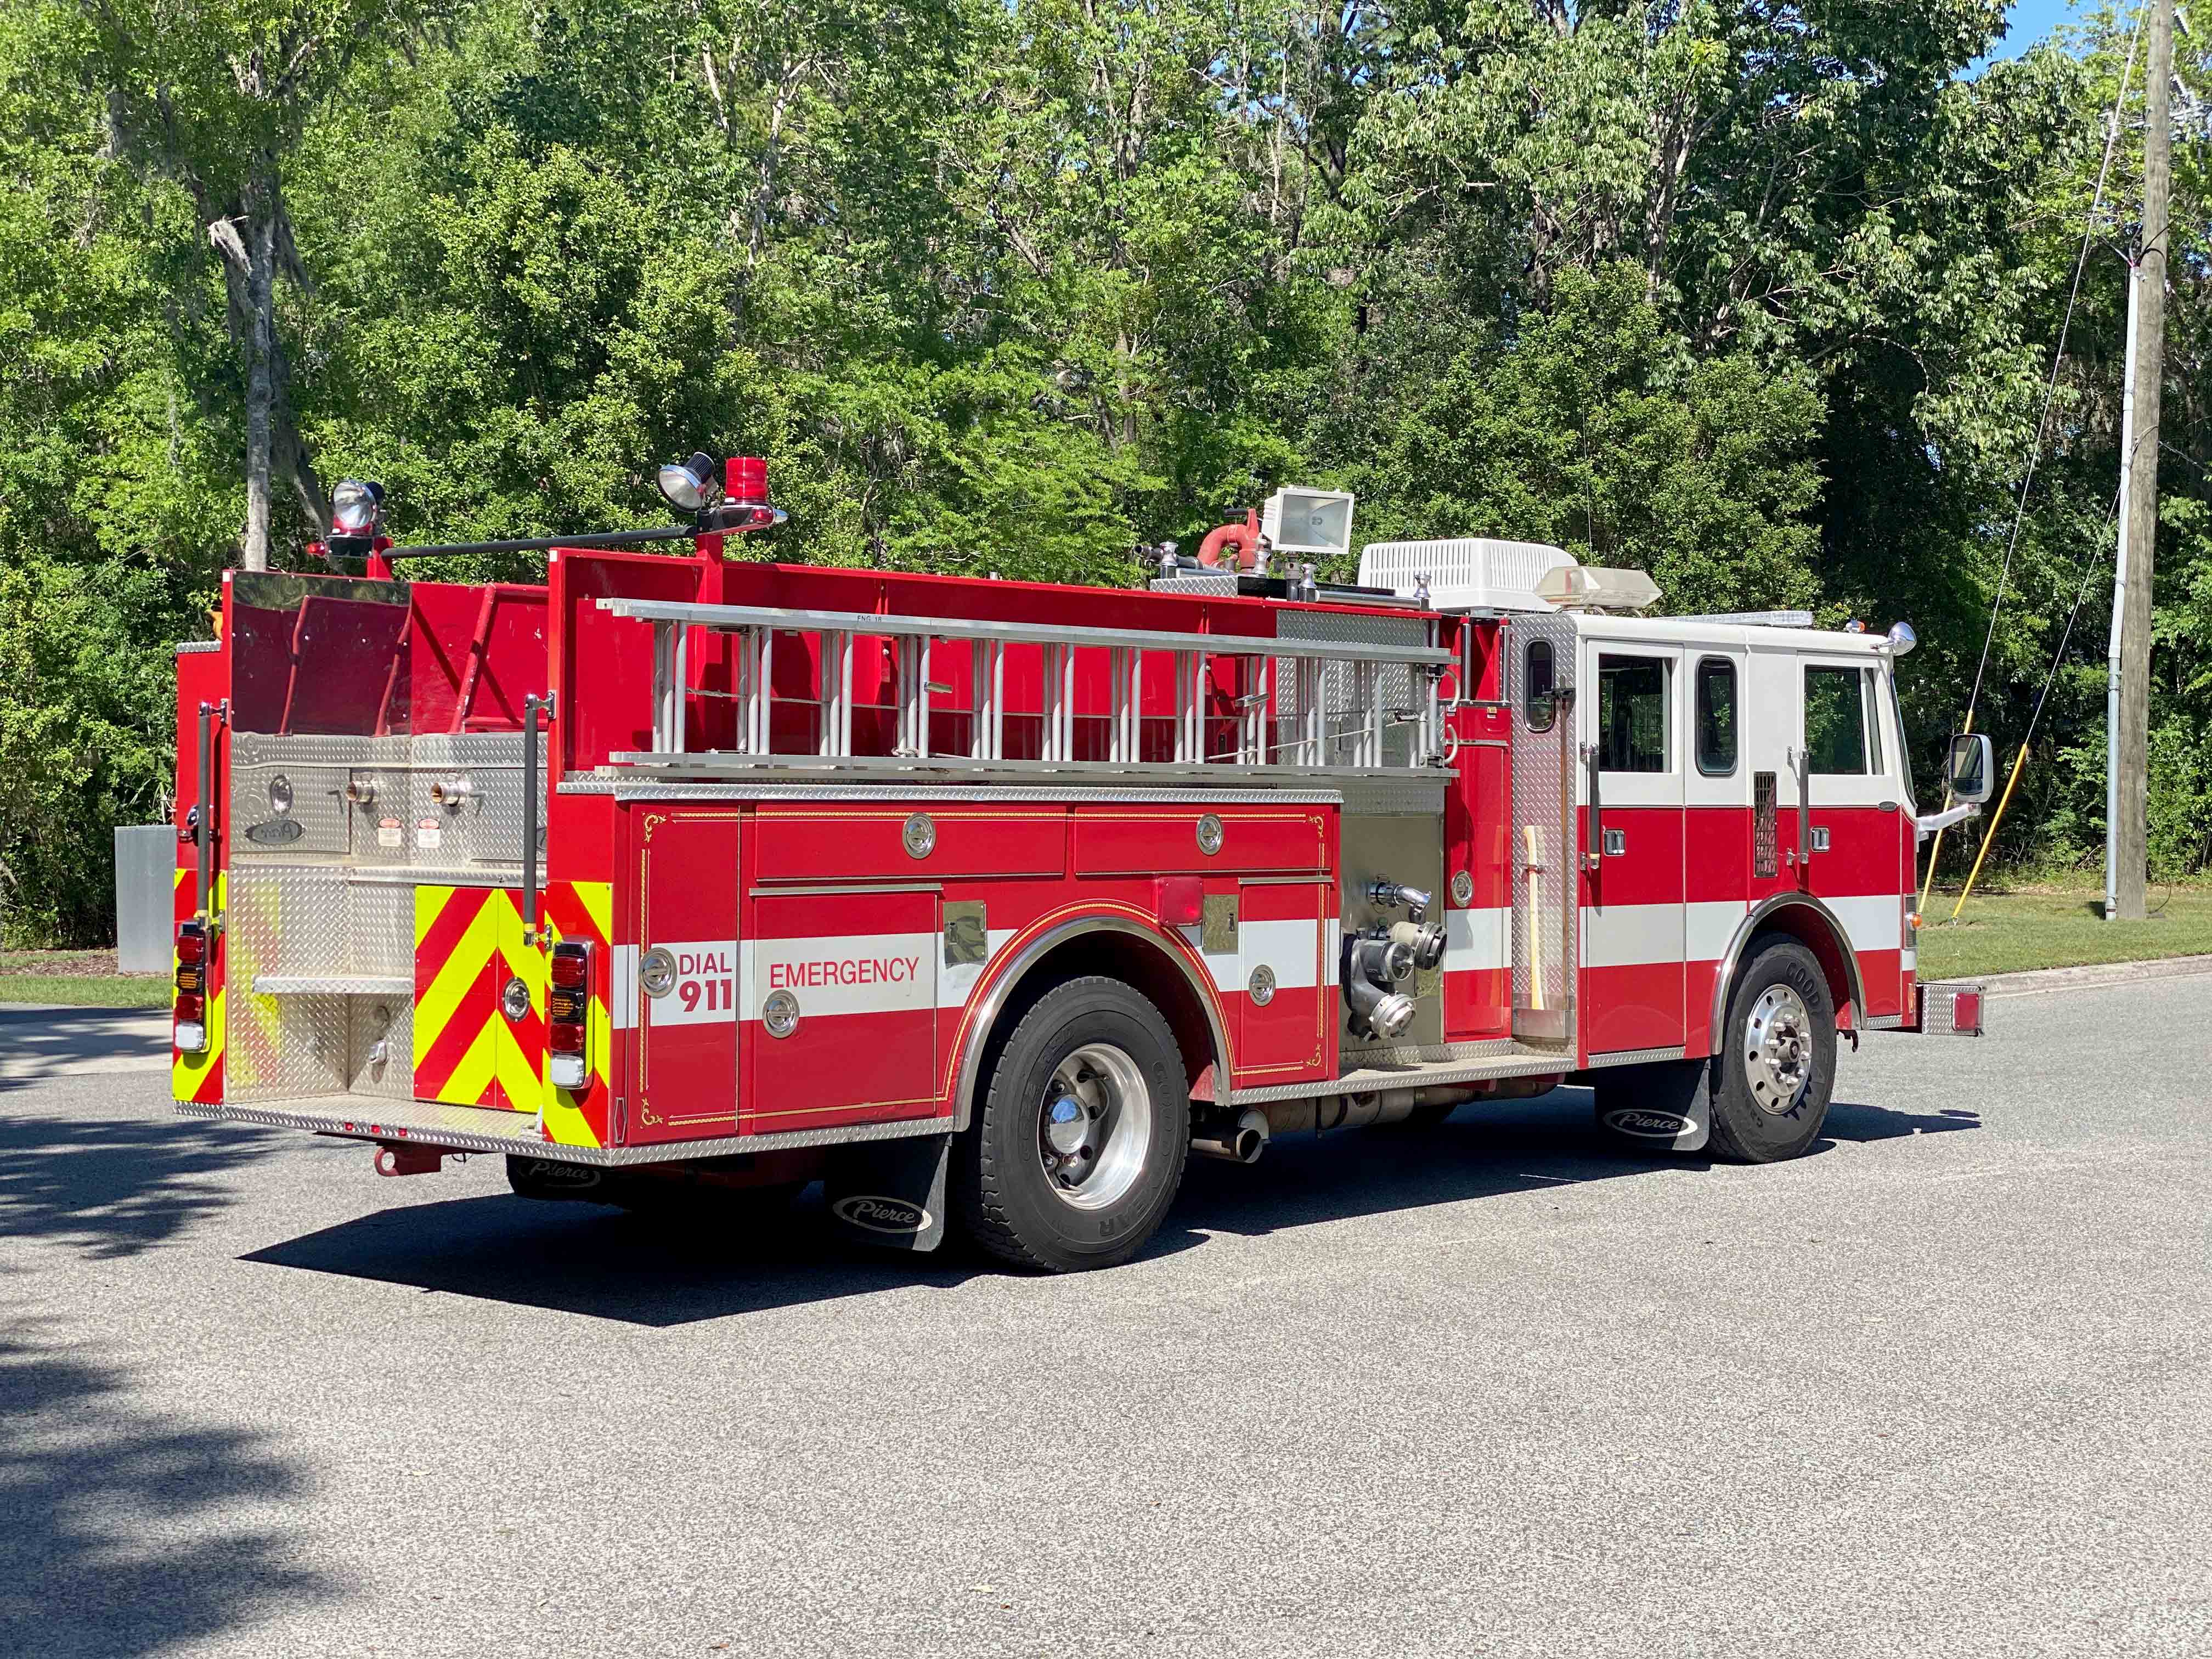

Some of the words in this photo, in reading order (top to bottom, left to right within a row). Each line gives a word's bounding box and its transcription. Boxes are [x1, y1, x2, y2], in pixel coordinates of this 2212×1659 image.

[679, 952, 732, 975] DIAL
[770, 956, 920, 989] EMERGENCY
[679, 979, 732, 1012] 911
[1619, 1112, 1680, 1130] Pierce
[529, 1160, 589, 1180] Pierce
[853, 1200, 916, 1223] Pierce
